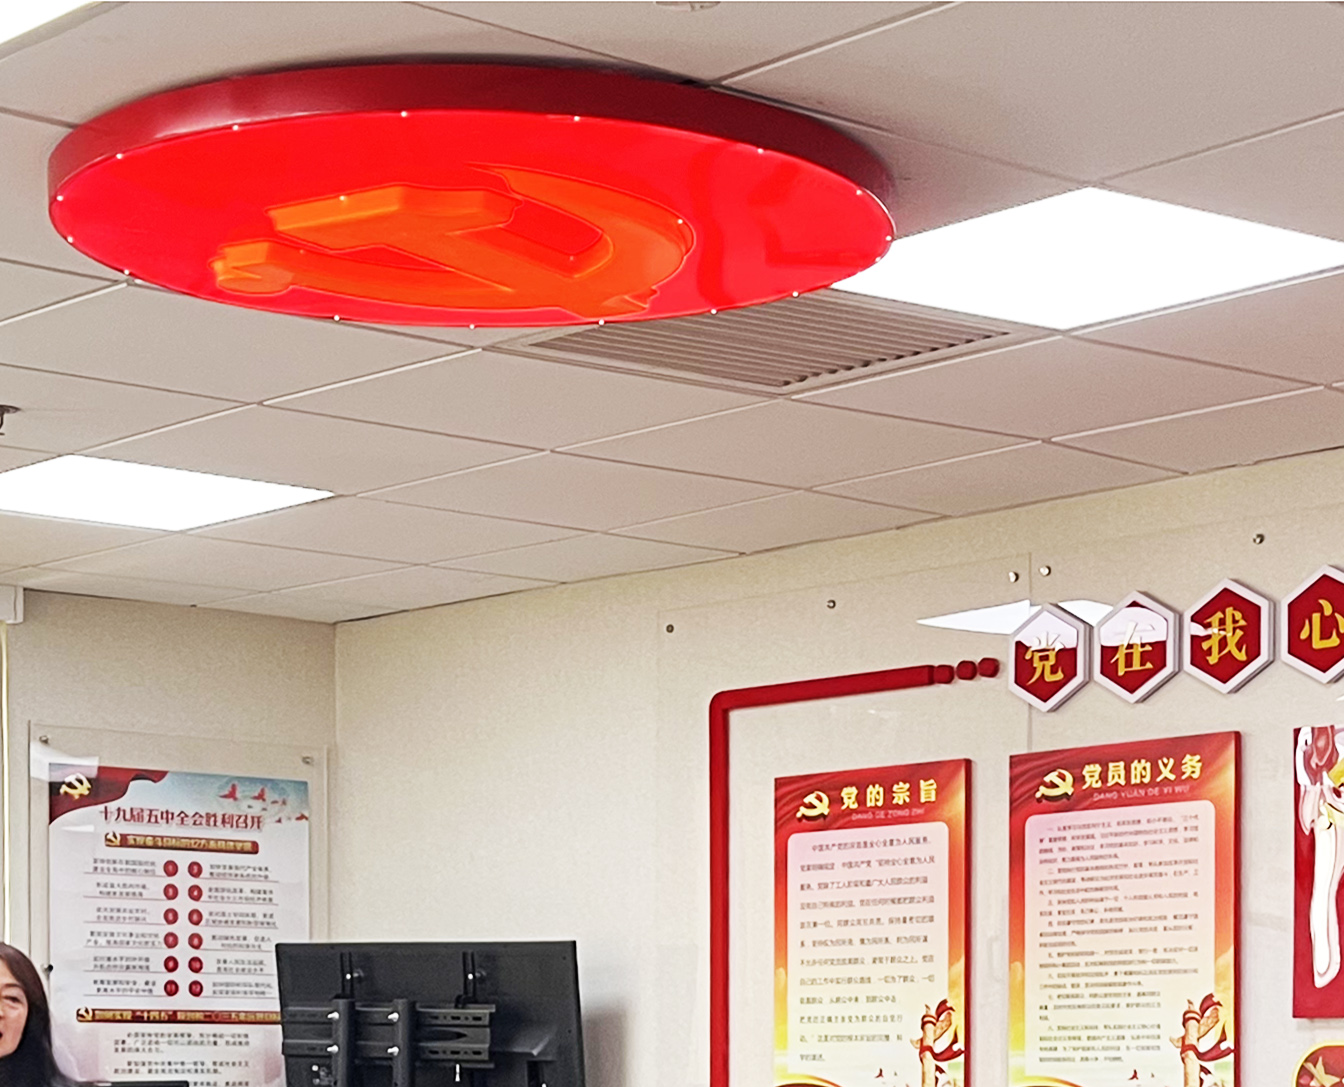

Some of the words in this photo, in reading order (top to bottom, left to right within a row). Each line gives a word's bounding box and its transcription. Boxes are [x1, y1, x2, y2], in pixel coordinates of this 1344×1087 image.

[1082, 754, 1203, 790] 党员的义务
[840, 779, 937, 810] 党的宗旨
[100, 806, 262, 831] 十九届五中全会胜利召开
